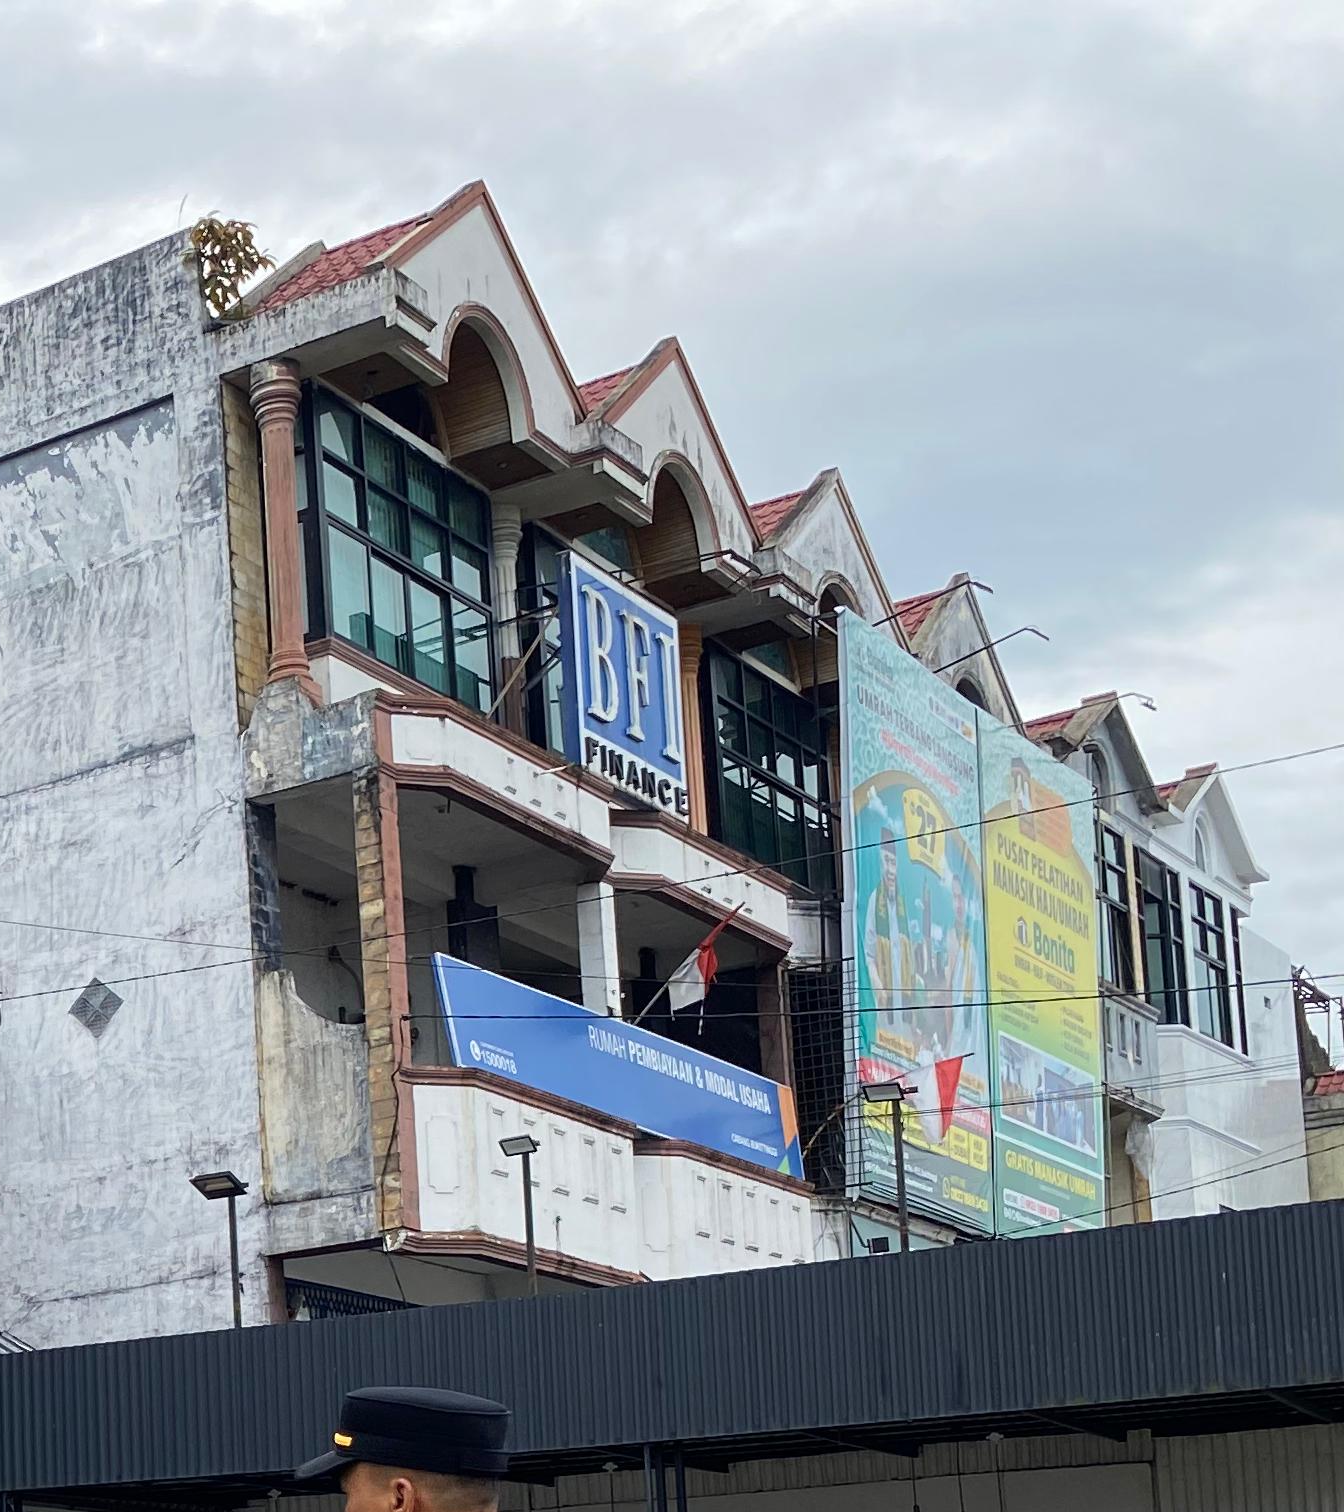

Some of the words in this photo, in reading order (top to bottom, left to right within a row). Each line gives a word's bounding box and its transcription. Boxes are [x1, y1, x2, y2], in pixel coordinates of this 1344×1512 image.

[581, 583, 681, 765] BFI
[584, 735, 689, 817] FINANCE
[993, 860, 1036, 909] MANASIK
[997, 831, 1030, 871] PUSAT
[1032, 854, 1084, 905] PELATIHAN
[1032, 920, 1076, 975] Bonita
[587, 1024, 626, 1060] RUMAH
[627, 1039, 694, 1085] PEMBIAYAAN
[695, 1066, 704, 1089] &
[705, 1070, 740, 1103] MODAL
[738, 1083, 772, 1115] USAHA
[1005, 1149, 1034, 1177] GRATIS
